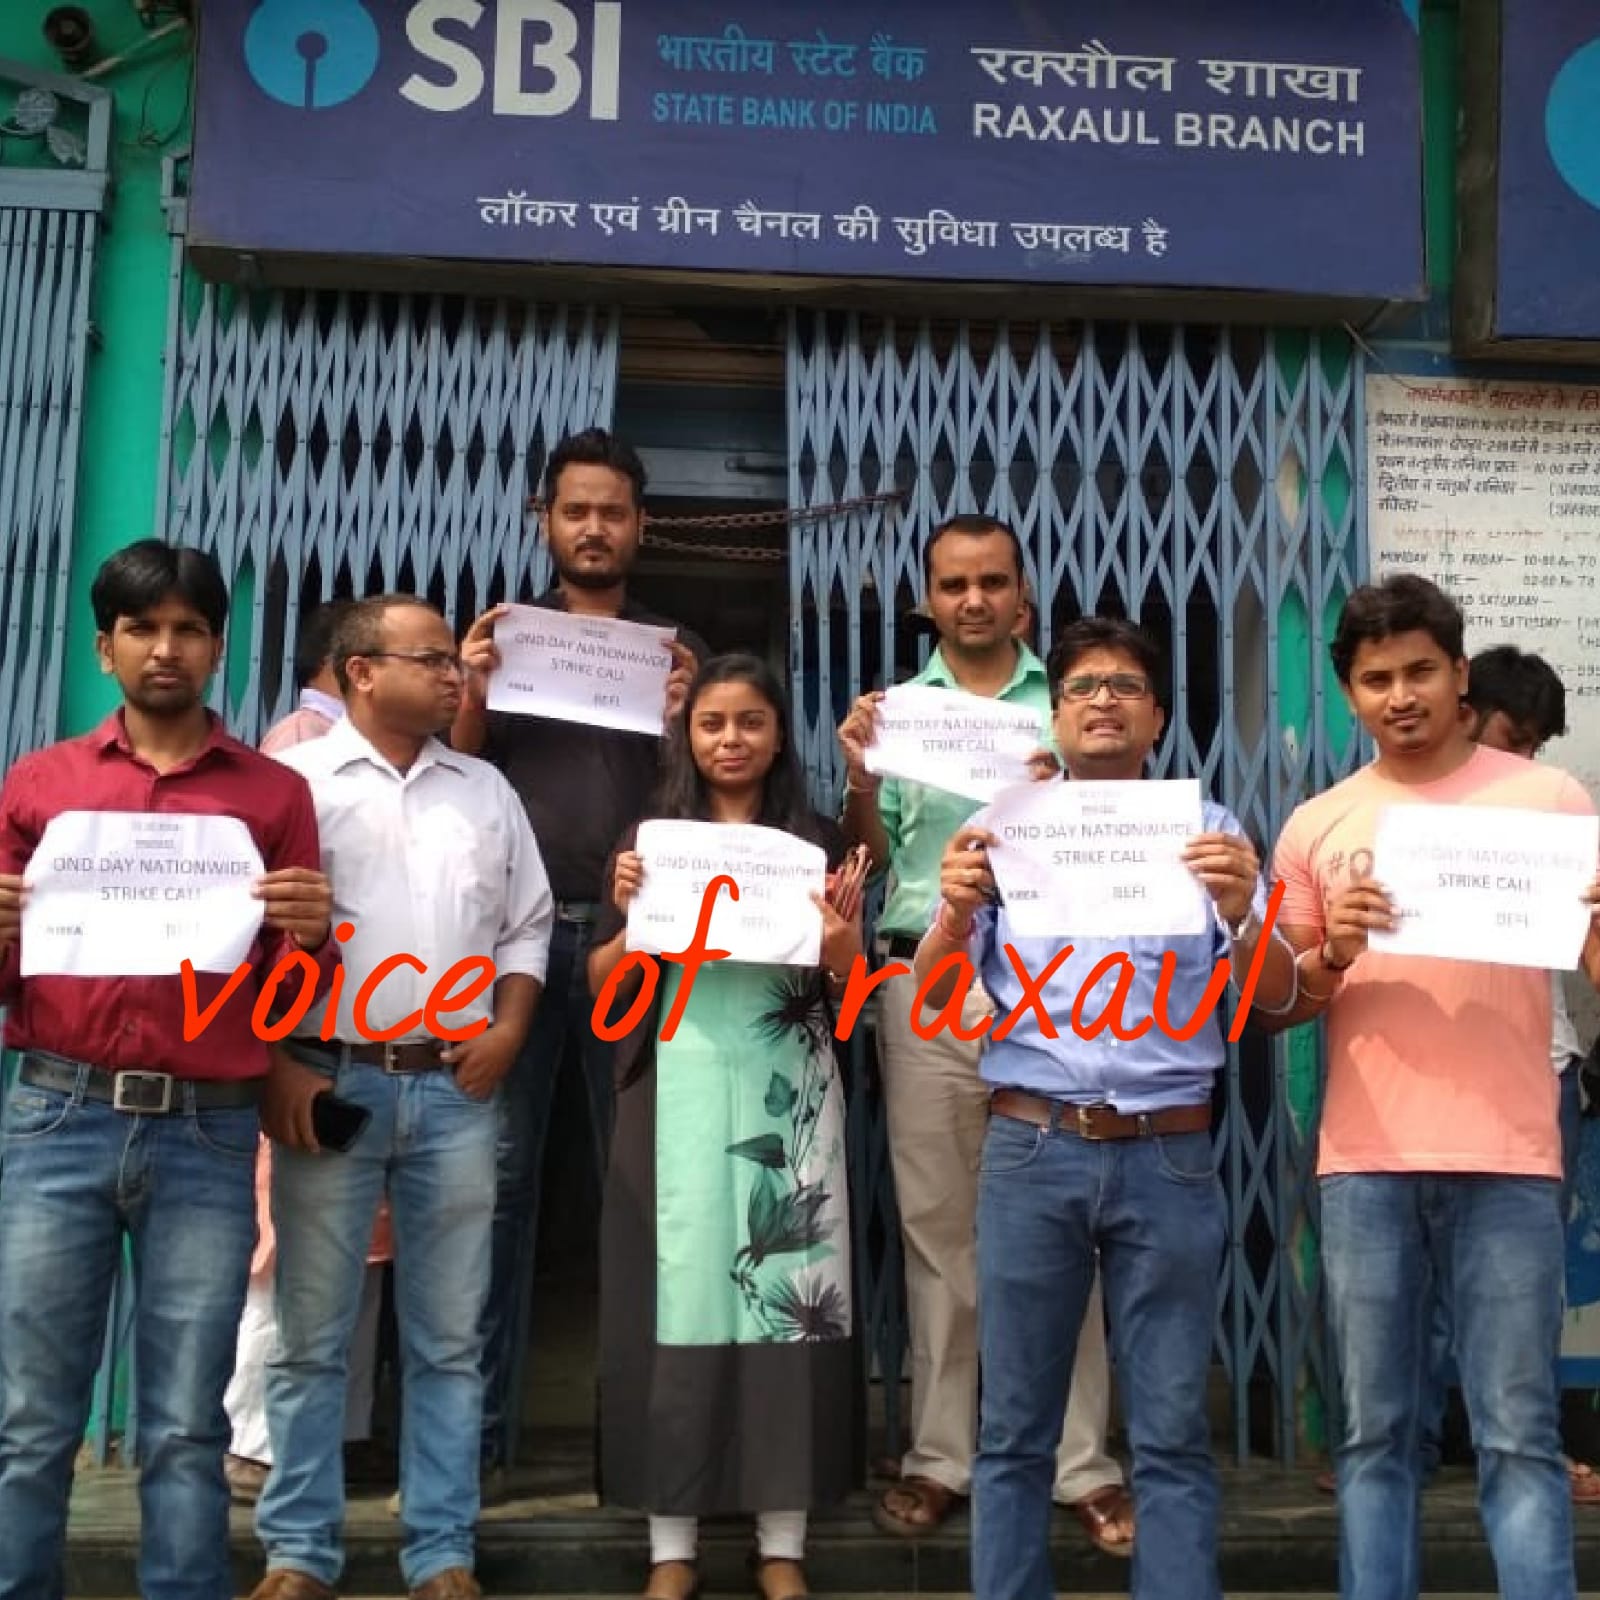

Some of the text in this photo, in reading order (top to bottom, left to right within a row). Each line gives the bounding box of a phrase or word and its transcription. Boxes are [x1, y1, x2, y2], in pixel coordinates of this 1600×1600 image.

[399, 0, 621, 120] SBI
[656, 24, 927, 81] भारतीय स्टेट बैंक
[971, 40, 1362, 102] रक्सौल शाखा
[653, 91, 937, 135] STATE BANK OF INDIA
[973, 104, 1364, 157] RAXAUL BRANCH
[477, 190, 1168, 256] लॉकर एवं ग्रीन चैनल की सुविधा उपलब्ध है
[1053, 850, 1148, 865] STRIKE CALL
